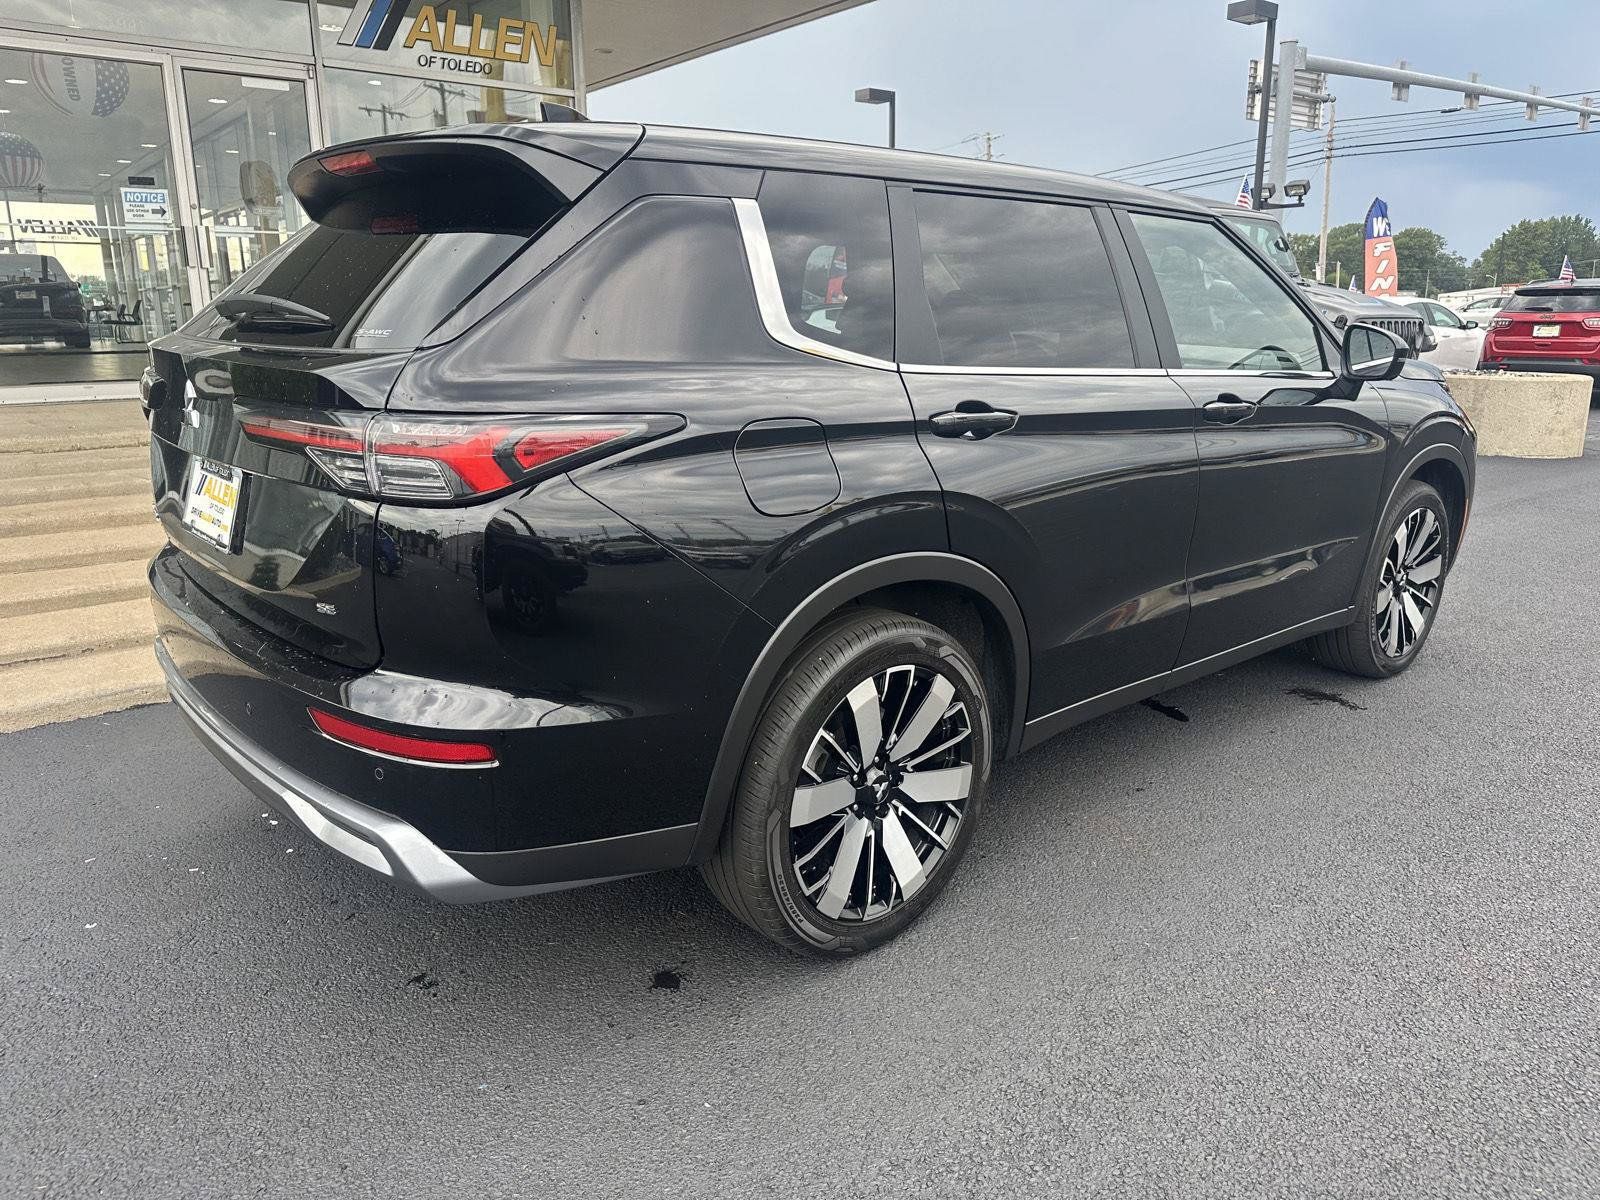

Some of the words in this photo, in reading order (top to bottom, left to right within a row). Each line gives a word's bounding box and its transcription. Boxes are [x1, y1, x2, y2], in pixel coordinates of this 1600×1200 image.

[403, 5, 558, 67] ALLEN
[61, 56, 81, 101] OWNED
[418, 54, 437, 68] OF
[439, 57, 492, 75] TOLEDO
[126, 192, 164, 203] NOTICE
[1369, 241, 1394, 297] FIN
[203, 476, 237, 510] ALLEN
